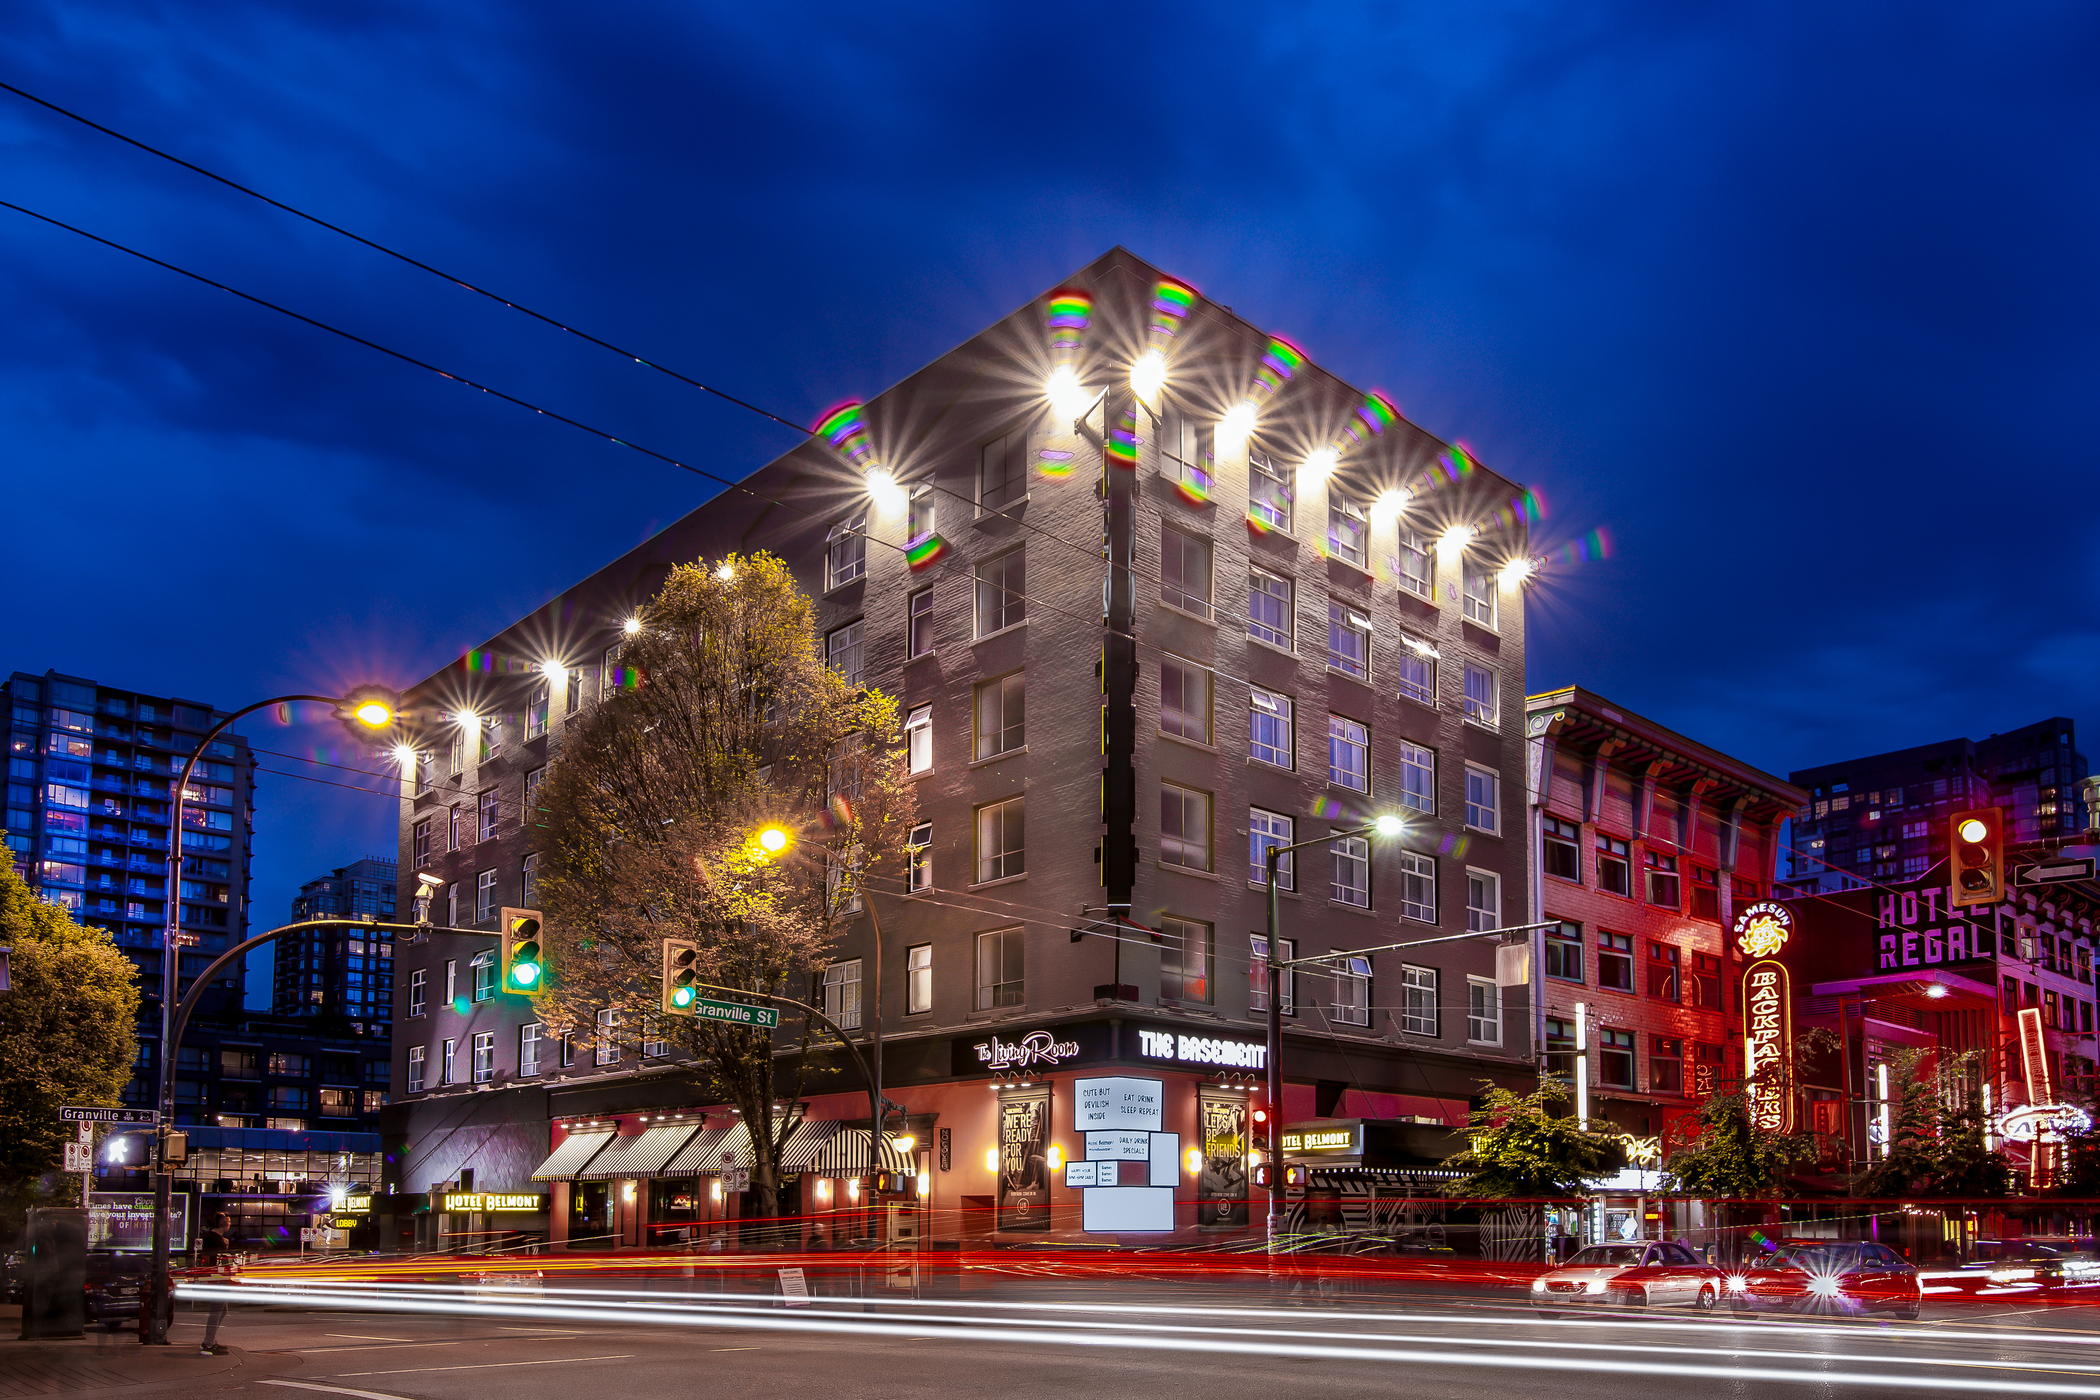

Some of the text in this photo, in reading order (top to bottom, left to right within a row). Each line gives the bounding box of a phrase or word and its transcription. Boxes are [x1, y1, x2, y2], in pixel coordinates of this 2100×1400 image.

[1734, 903, 1791, 933] SAMESUN
[1880, 926, 1991, 969] REGAL
[695, 1001, 772, 1024] Granville St
[988, 1036, 1031, 1070] Living
[1139, 1030, 1266, 1068] THE BASEMENT
[1083, 1088, 1110, 1097] CUTE BUT
[1123, 1093, 1154, 1103] EAT DRINK
[1084, 1100, 1110, 1109] DEVILISH
[1120, 1105, 1159, 1116] SLEEP REPEAT
[64, 1109, 119, 1121] Granville
[1006, 1113, 1032, 1129] WE'RE
[1087, 1111, 1106, 1120] INSIDE
[1006, 1127, 1032, 1143] READY
[1119, 1136, 1149, 1145] DAILY DRINK
[1206, 1128, 1217, 1143] BE
[1304, 1132, 1350, 1150] BELMONT
[1006, 1143, 1022, 1157] FOR
[1206, 1143, 1241, 1158] FRIENDS
[113, 1201, 133, 1210] have
[347, 1196, 370, 1212] BELMONT
[446, 1195, 539, 1211] HOTEL BELMONT
[119, 1221, 130, 1229] OF
[336, 1219, 357, 1228] LOBBY
